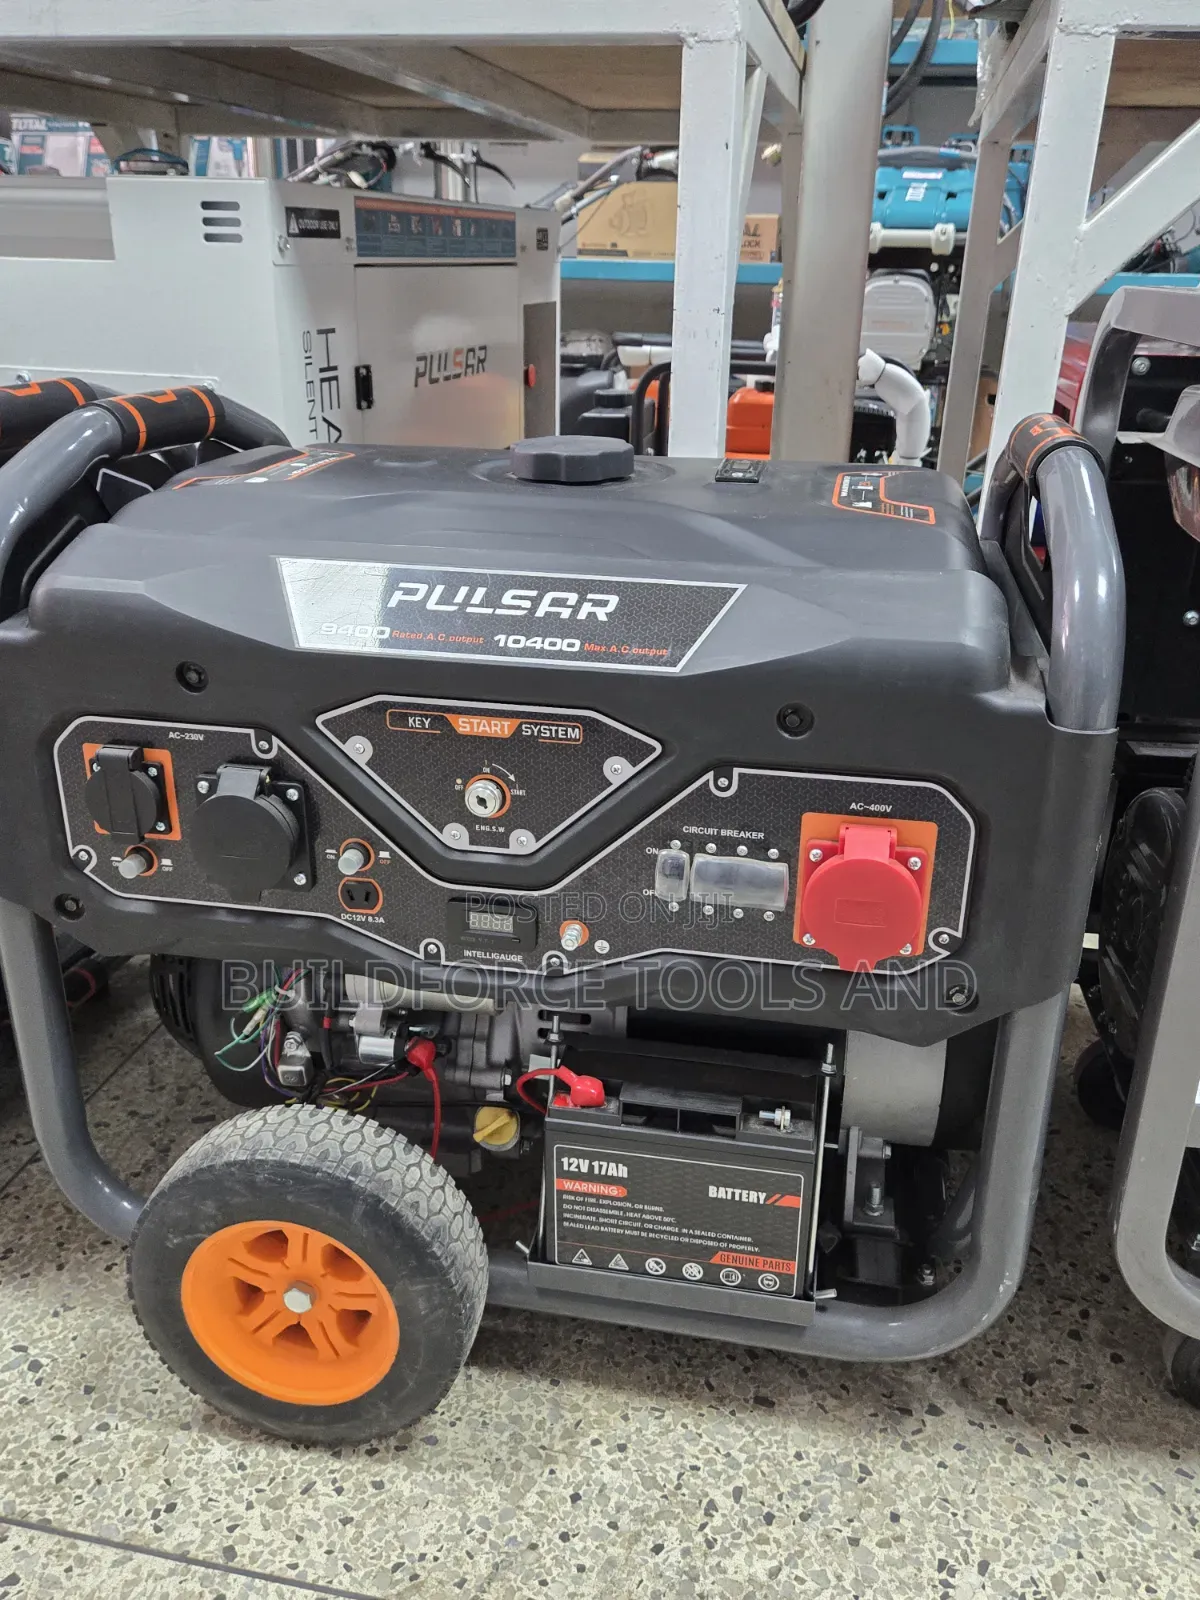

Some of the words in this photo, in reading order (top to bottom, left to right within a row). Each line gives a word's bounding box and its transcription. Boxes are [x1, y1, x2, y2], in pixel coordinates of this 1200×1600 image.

[414, 345, 488, 388] PULSAR
[302, 330, 318, 440] SILENT
[387, 582, 619, 621] PULSAR
[320, 622, 391, 639] 9400
[392, 630, 423, 640] Rated
[448, 635, 485, 645] output
[493, 634, 581, 652] 10400
[584, 642, 607, 652] Max
[632, 647, 669, 656] output
[408, 716, 431, 729] KEY
[458, 718, 511, 736] START
[521, 724, 580, 740] SYSTEM
[482, 766, 491, 774] ON
[454, 784, 464, 792] OFF
[510, 788, 526, 797] START
[682, 825, 719, 836] CIRCUIT
[720, 829, 765, 840] BREAKER
[645, 846, 660, 855] ON
[341, 913, 366, 922] DC12V
[367, 916, 385, 924] 8.3A
[463, 949, 523, 962] INTELLIGAUGE
[561, 1156, 590, 1173] 12V
[591, 1160, 628, 1178] 17Ah
[563, 1180, 622, 1196] WARNING:
[708, 1185, 767, 1205] BATTERY
[626, 1211, 641, 1219] HEAT
[642, 1213, 663, 1222] ABOVE
[585, 1223, 600, 1231] LEAD
[600, 1226, 625, 1235] BATTERY
[625, 1229, 640, 1237] MUST
[648, 1232, 680, 1242] RECYCLED
[654, 1224, 679, 1233] CHARGE
[720, 1254, 760, 1268] GENUINE
[762, 1259, 792, 1272] PARTS
